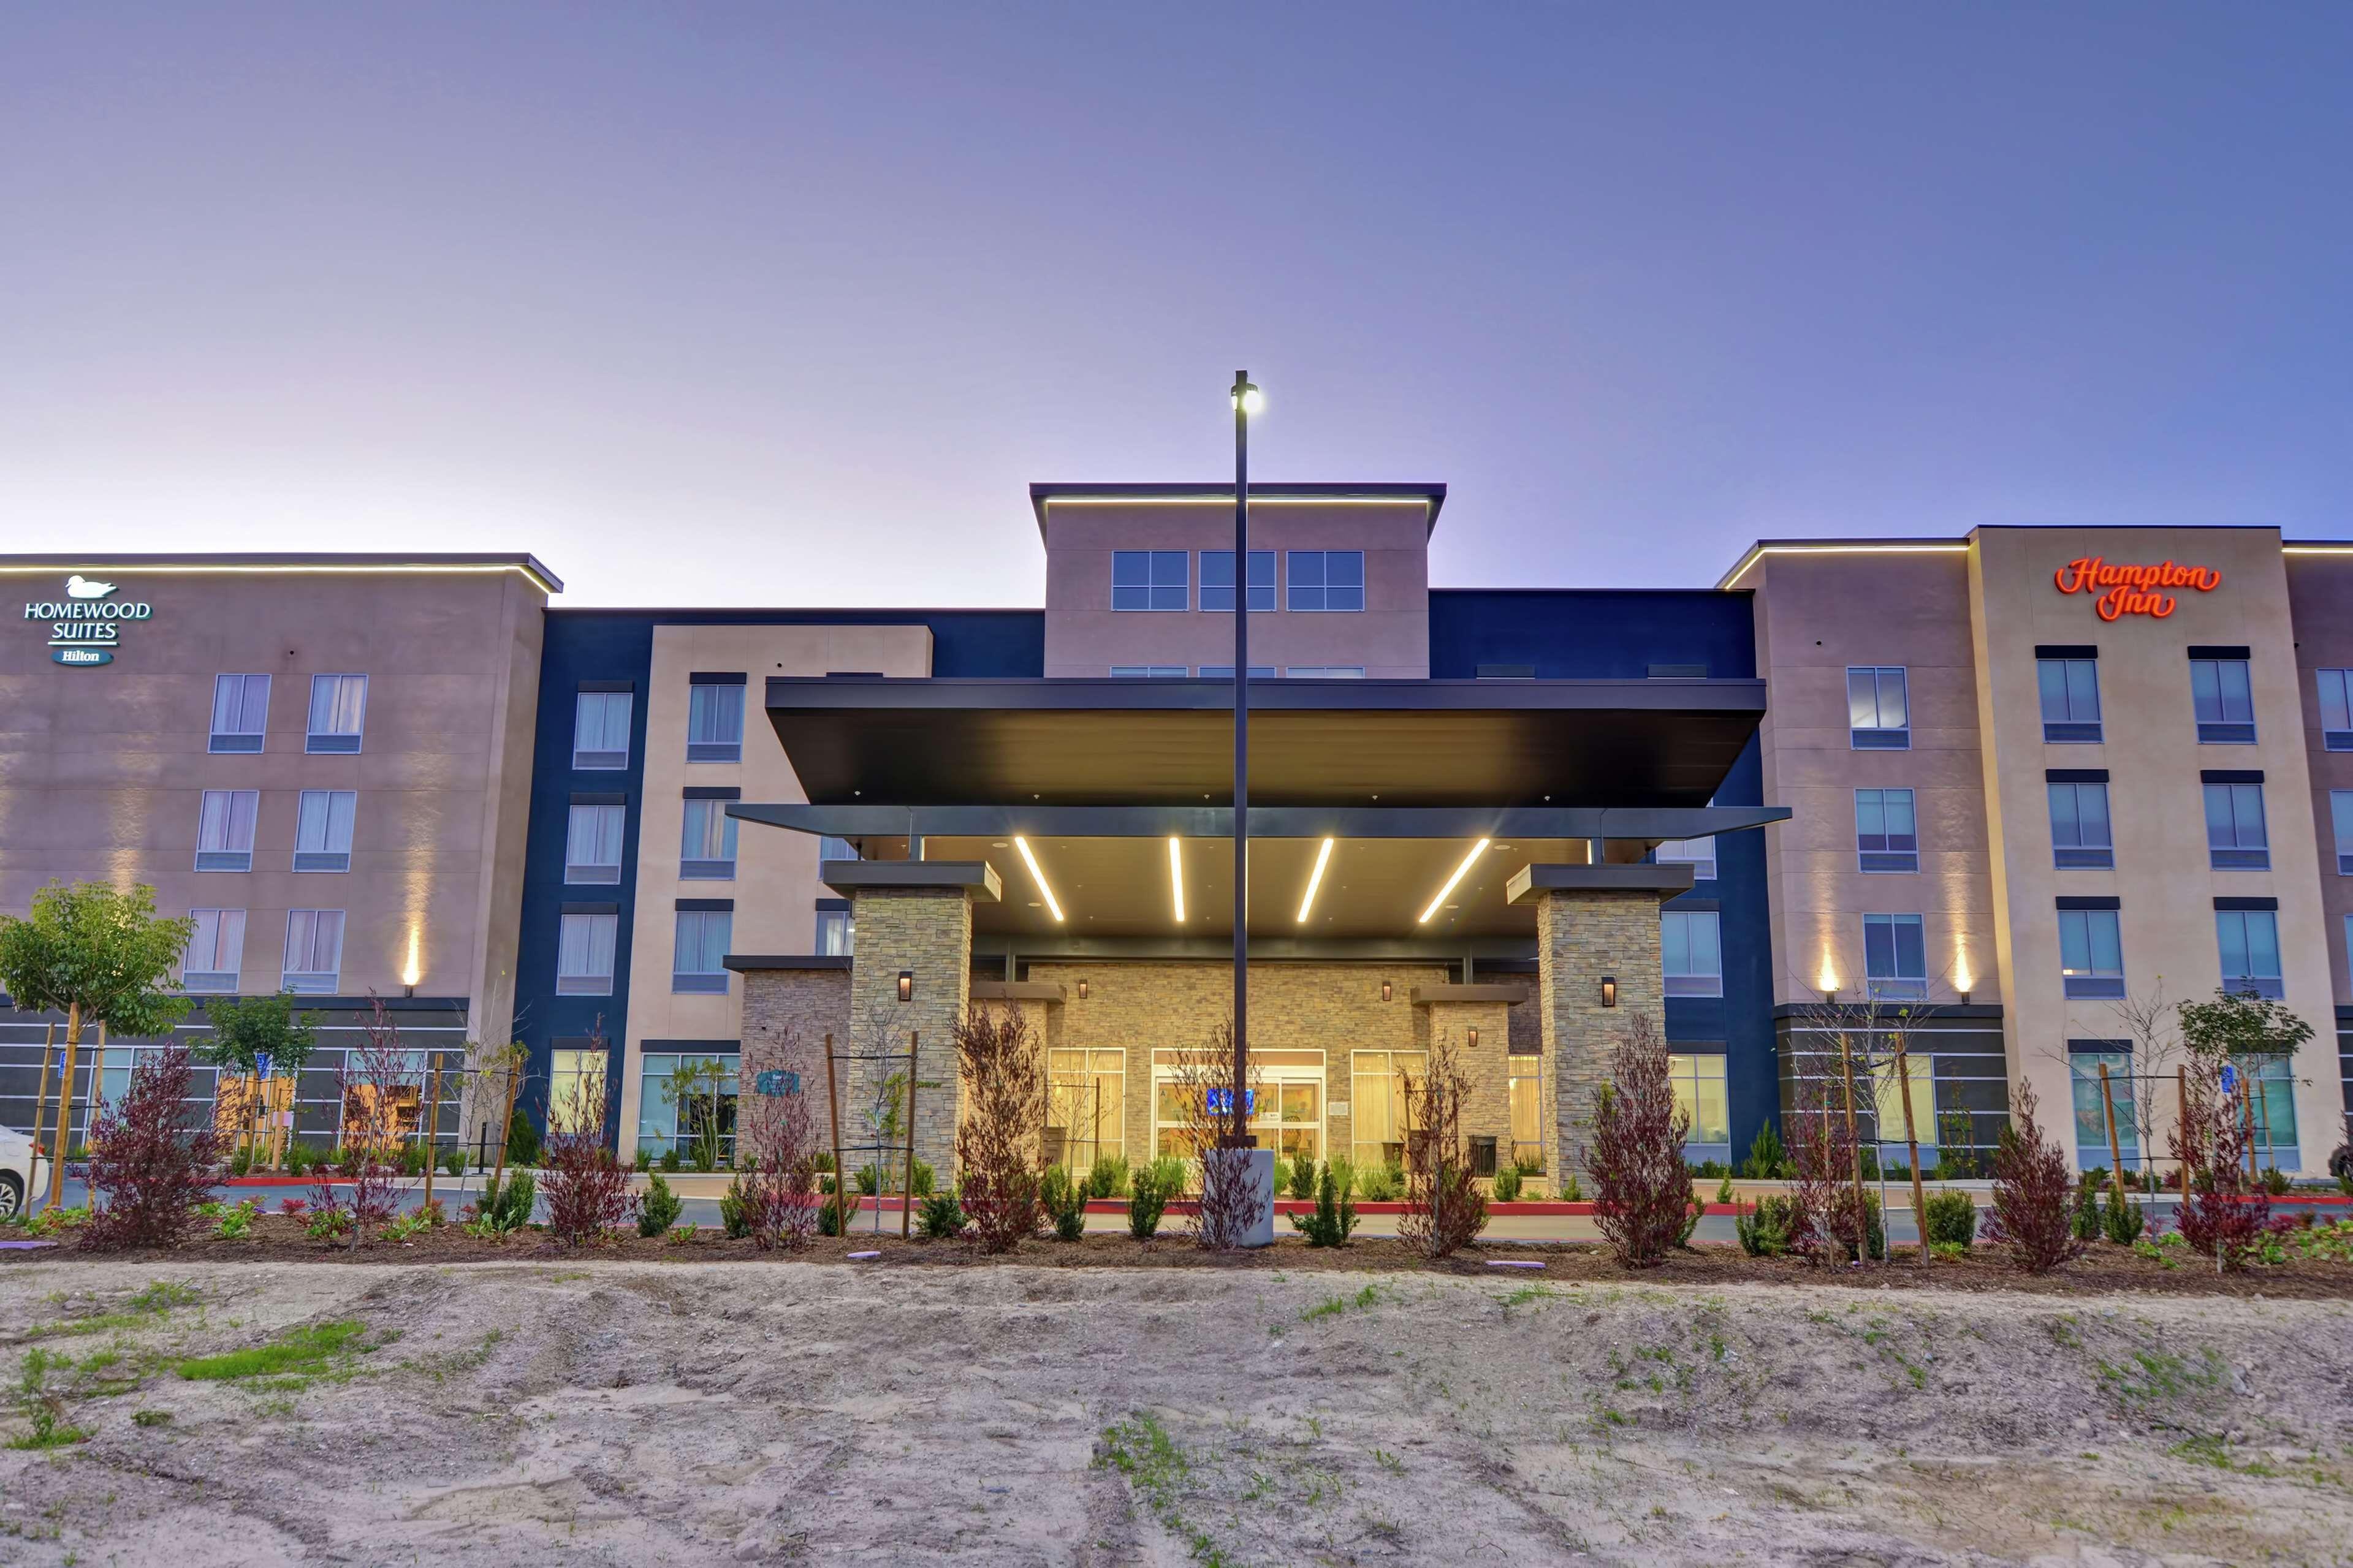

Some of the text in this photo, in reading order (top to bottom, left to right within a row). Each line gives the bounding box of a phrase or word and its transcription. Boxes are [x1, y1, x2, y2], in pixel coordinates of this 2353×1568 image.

[2054, 556, 2222, 594] Hampton
[25, 603, 151, 619] HOMEWOOD
[2096, 585, 2176, 622] Inn
[51, 623, 117, 638] SUITES
[62, 650, 100, 661] Hilton
